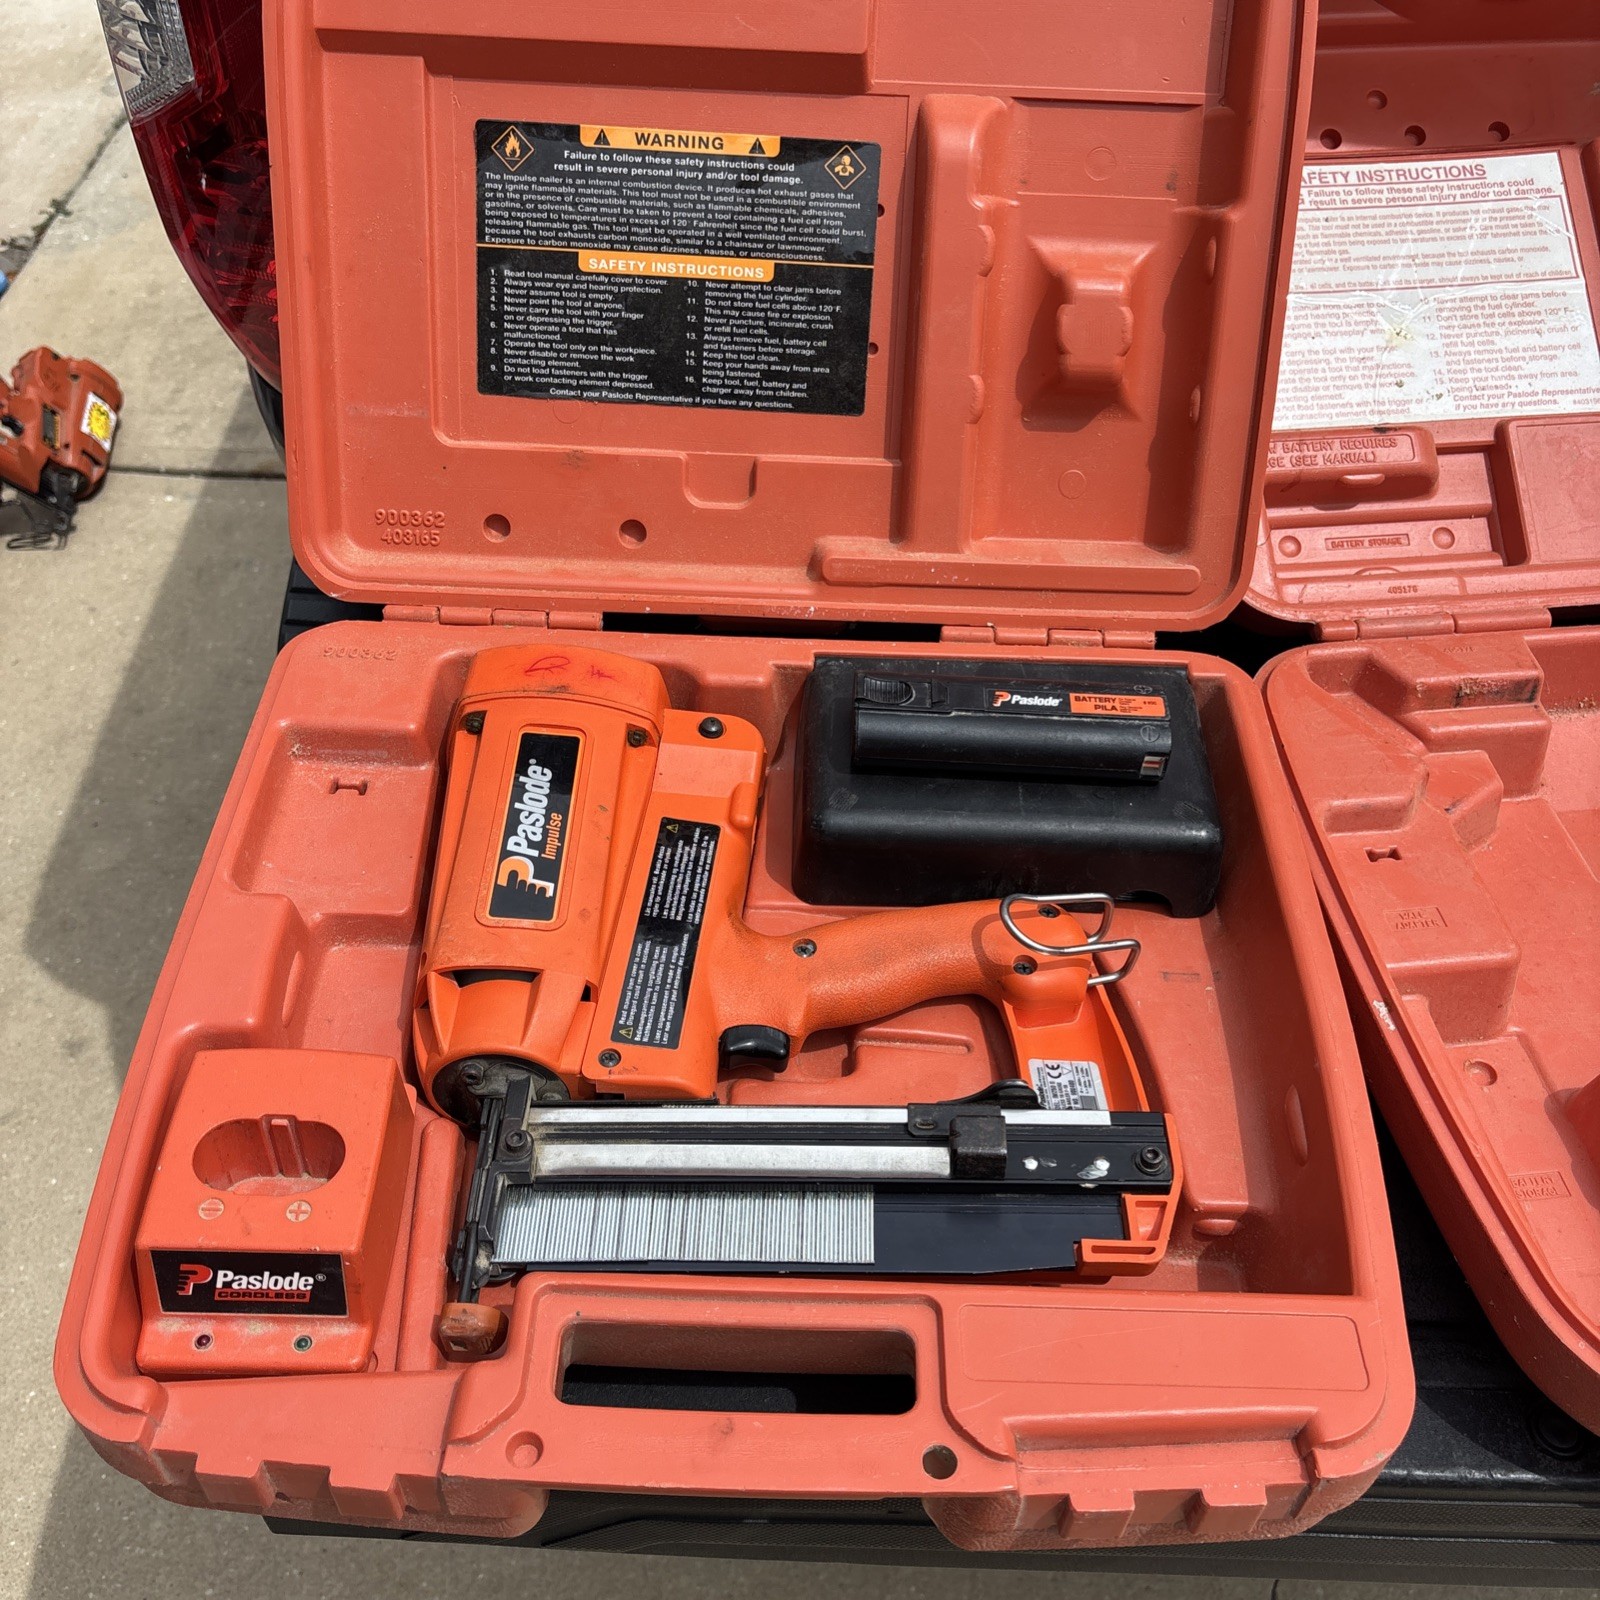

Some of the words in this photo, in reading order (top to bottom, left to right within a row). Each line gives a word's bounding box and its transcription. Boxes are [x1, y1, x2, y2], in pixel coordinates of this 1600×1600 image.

[635, 134, 724, 150] WARNING
[564, 151, 596, 161] Failure
[600, 153, 609, 161] to
[612, 154, 642, 163] follow
[645, 156, 671, 165] these
[674, 158, 704, 169] safety
[707, 159, 764, 170] instructions
[767, 163, 795, 172] could
[554, 164, 581, 172] result
[584, 164, 593, 173] in
[631, 169, 672, 177] personal
[675, 169, 702, 181] injury
[705, 171, 737, 180] and/or
[740, 173, 759, 182] tool
[762, 174, 804, 186] damage.
[1356, 164, 1486, 182] INSTRUCTIONS
[485, 172, 500, 180] The
[503, 173, 536, 183] Impulse
[539, 176, 562, 184] nailer
[588, 178, 620, 187] internal
[622, 181, 672, 190] combustion
[674, 183, 704, 191] device.
[715, 186, 755, 194] produces
[757, 187, 771, 195] hot
[774, 189, 807, 197] exhaust
[837, 192, 854, 200] that
[1307, 189, 1340, 197] Failure
[1342, 188, 1352, 196] to
[1354, 187, 1384, 195] follow
[1386, 186, 1413, 194] these
[1415, 184, 1444, 193] safety
[1447, 181, 1504, 190] instructions
[1507, 179, 1534, 188] could
[1309, 197, 1336, 206] result
[1350, 196, 1382, 204] severe
[1385, 193, 1426, 204] personal
[1429, 193, 1456, 201] injury
[1459, 190, 1490, 199] and/or
[1492, 189, 1511, 197] tool
[1514, 188, 1555, 197] damage.
[503, 269, 525, 278] Read
[526, 271, 542, 279] tool
[575, 274, 608, 284] carefully
[634, 276, 643, 284] to
[588, 258, 645, 272] SAFETY
[651, 262, 764, 279] INSTRUCTIONS
[503, 278, 532, 288] Always
[555, 282, 570, 290] eye
[588, 282, 618, 293] hearing
[620, 285, 662, 294] protection.
[503, 287, 527, 295] Never
[562, 289, 577, 297] tool
[579, 290, 586, 298] is
[588, 291, 616, 301] empty.
[688, 279, 698, 287] 10.
[705, 280, 728, 288] Never
[730, 282, 761, 292] attempt
[763, 283, 771, 291] to
[773, 284, 793, 292] clear
[815, 286, 841, 295] before
[503, 296, 527, 304] Never
[529, 297, 549, 306] point
[551, 298, 564, 306] the
[566, 299, 582, 307] tool
[593, 302, 625, 310] anyone.
[503, 304, 527, 313] Never
[528, 307, 549, 316] carry
[551, 307, 564, 315] the
[566, 308, 581, 316] tool
[602, 311, 619, 319] your
[621, 310, 644, 320] finger
[550, 388, 580, 396] Contact
[601, 390, 633, 399] Paslode
[635, 392, 693, 403] Representative
[718, 397, 736, 405] have
[738, 400, 752, 408] any
[1453, 392, 1484, 401] Contact
[1486, 393, 1504, 401] your
[1507, 390, 1539, 398] Paslode
[1455, 402, 1460, 410] if
[1462, 403, 1477, 411] you
[1479, 401, 1499, 409] have
[1282, 440, 1335, 454] BATTERY
[1340, 438, 1397, 450] REQUIRES
[1290, 455, 1318, 466] (SEE
[1323, 451, 1376, 465] MANUAL)
[375, 509, 445, 528] 900362
[381, 529, 440, 546] 403165
[1331, 540, 1365, 548] BATTERY
[1074, 696, 1116, 704] BATTERY
[1094, 704, 1118, 712] PILA
[541, 812, 562, 860] Impulse
[218, 1291, 306, 1300] CORDLESS
